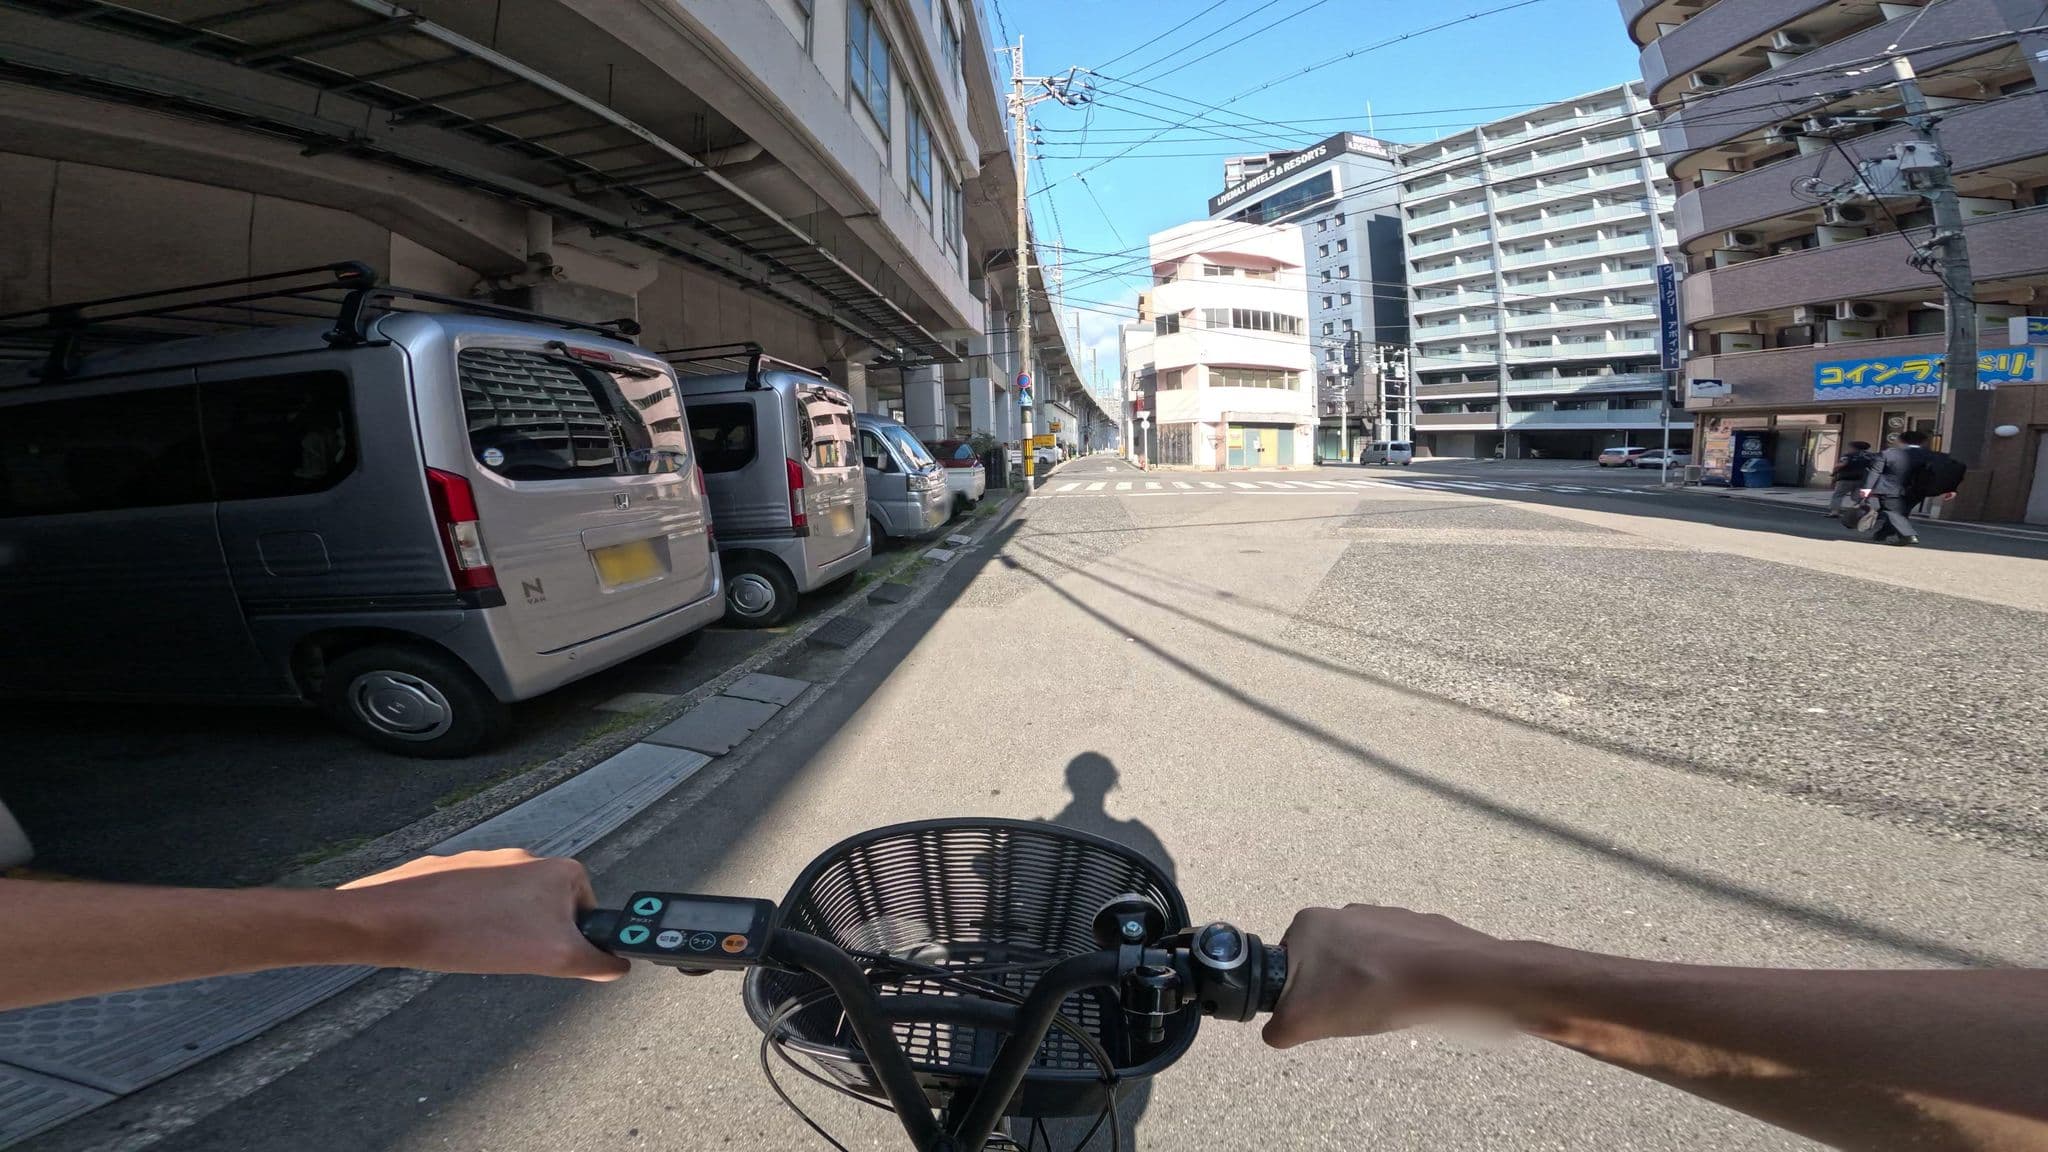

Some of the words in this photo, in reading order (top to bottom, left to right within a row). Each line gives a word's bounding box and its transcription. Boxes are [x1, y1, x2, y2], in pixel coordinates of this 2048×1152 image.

[1217, 185, 1246, 206] LIVEMAX
[1246, 169, 1276, 191] HOTELS
[1276, 166, 1284, 176] &
[1283, 145, 1327, 172] RESORTS
[521, 577, 544, 598] N
[693, 937, 713, 945] ライト
